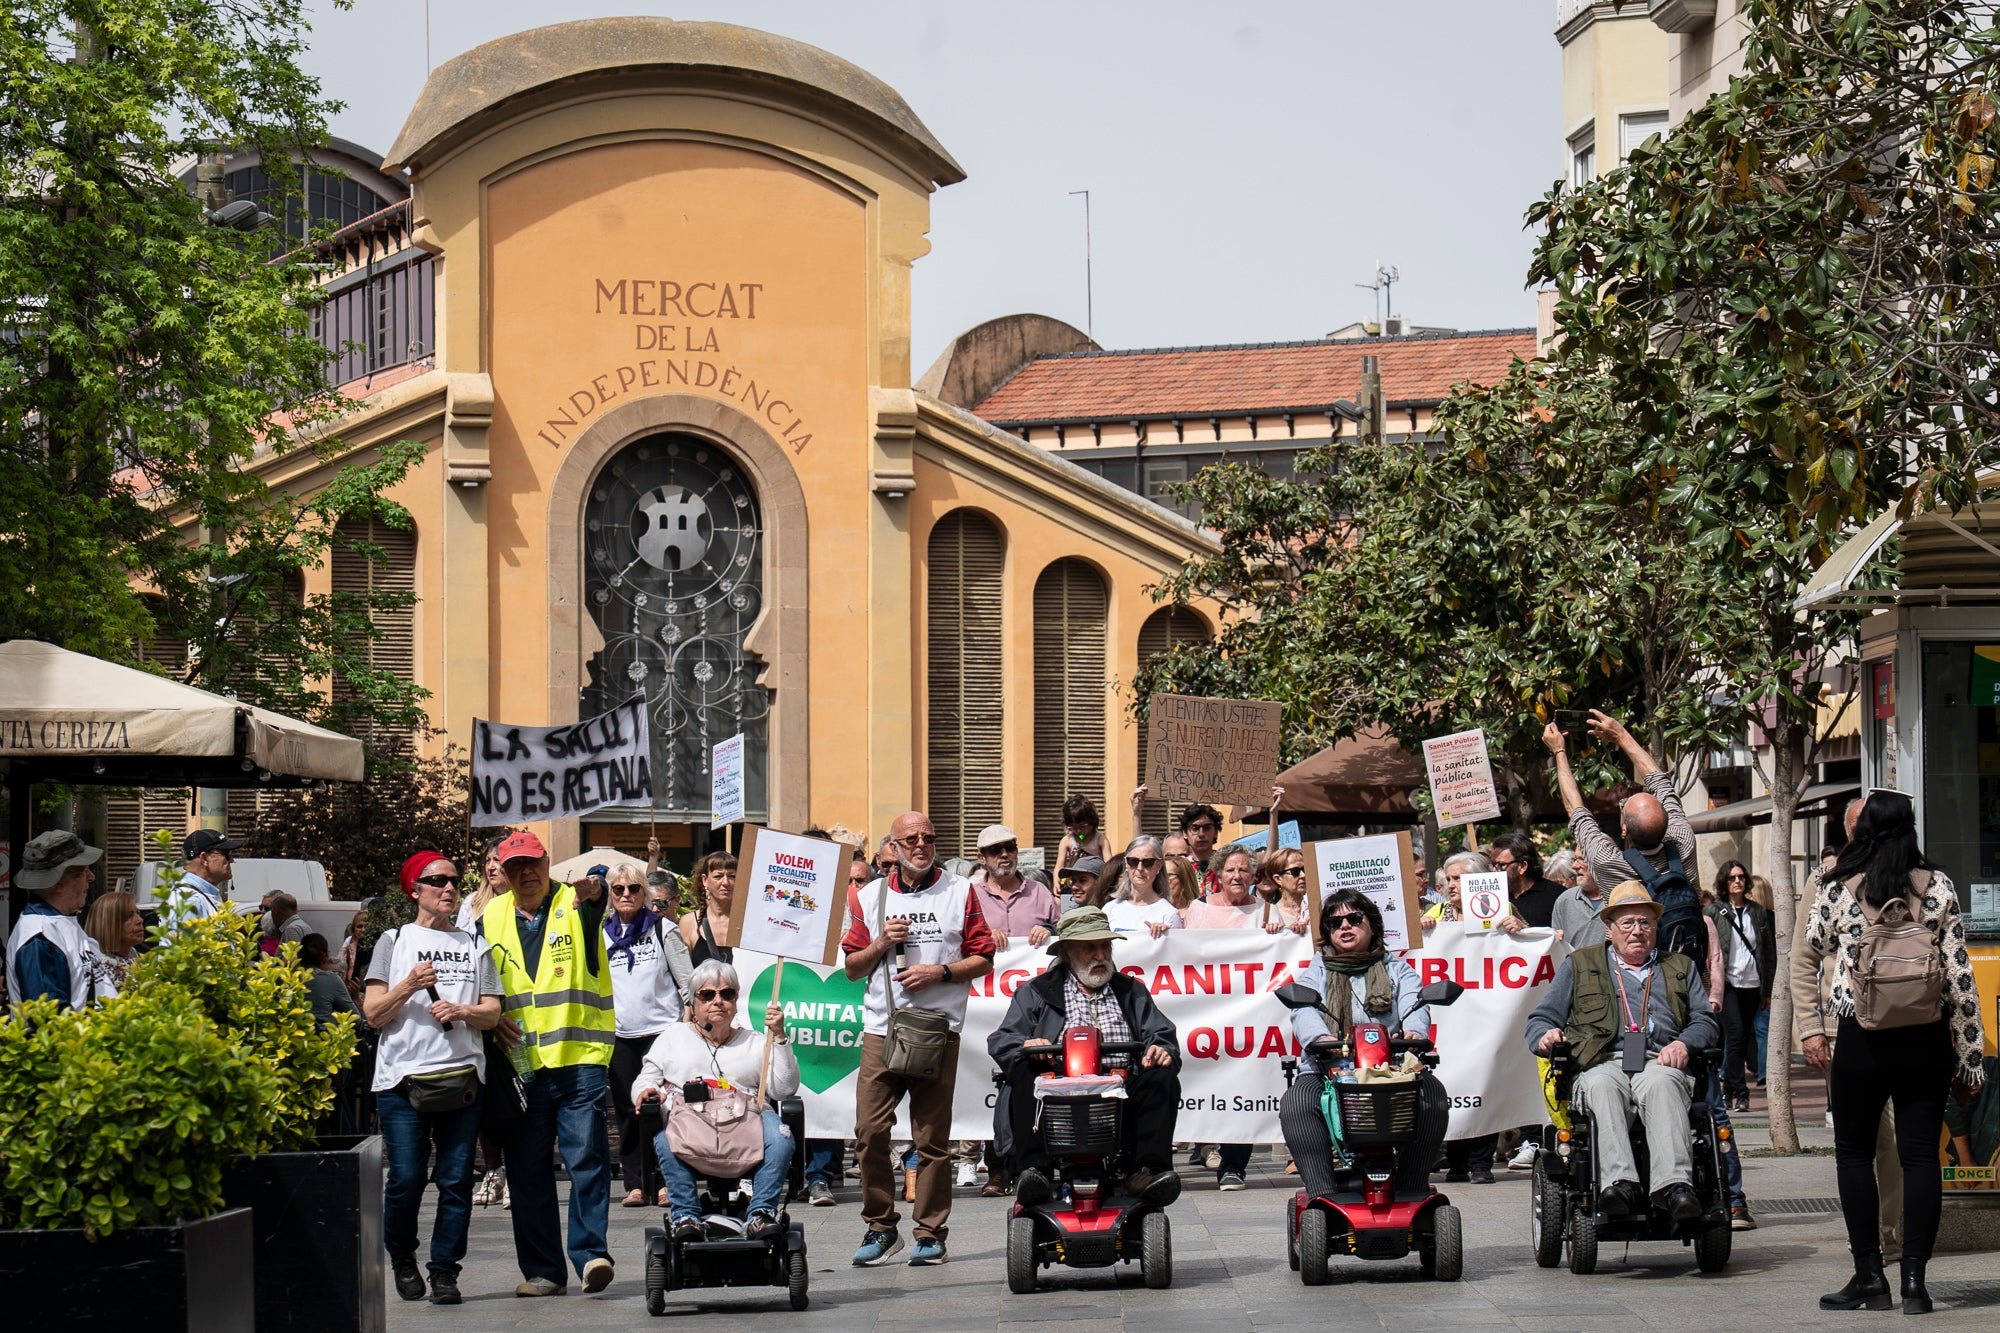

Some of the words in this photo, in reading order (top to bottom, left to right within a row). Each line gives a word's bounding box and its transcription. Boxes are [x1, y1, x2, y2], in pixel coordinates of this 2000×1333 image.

[595, 278, 763, 319] MERCAT
[636, 325, 676, 351] DE
[685, 326, 720, 352] LA
[538, 359, 813, 455] INDEPENDÈNCIA
[1157, 697, 1218, 722] MIENTRAS
[40, 721, 131, 748] CEREZA
[1156, 720, 1173, 742] SE
[480, 722, 531, 761] LA
[1428, 741, 1453, 750] Sanitat
[1454, 736, 1479, 745] Pública
[1154, 743, 1173, 765] CON
[1432, 764, 1441, 773] la
[1155, 765, 1171, 783] AL
[1173, 768, 1205, 789] RESTO
[1207, 772, 1226, 792] NOS
[1434, 770, 1473, 789] pública
[471, 775, 513, 814] NO
[521, 772, 555, 814] ES
[1442, 794, 1452, 802] de
[1455, 786, 1489, 800] Qualitat
[775, 852, 814, 870] VOLEM
[1329, 856, 1390, 872] REHABILITACIÓ
[768, 864, 816, 881] ESPECIALISTES
[1336, 867, 1384, 880] CONTINUADA
[778, 876, 811, 888] DISCAPACITAT
[1469, 884, 1501, 892] GUERRA
[417, 951, 471, 963] MAREA
[1211, 1094, 1226, 1111] la
[1957, 1169, 1992, 1178] ONCE
